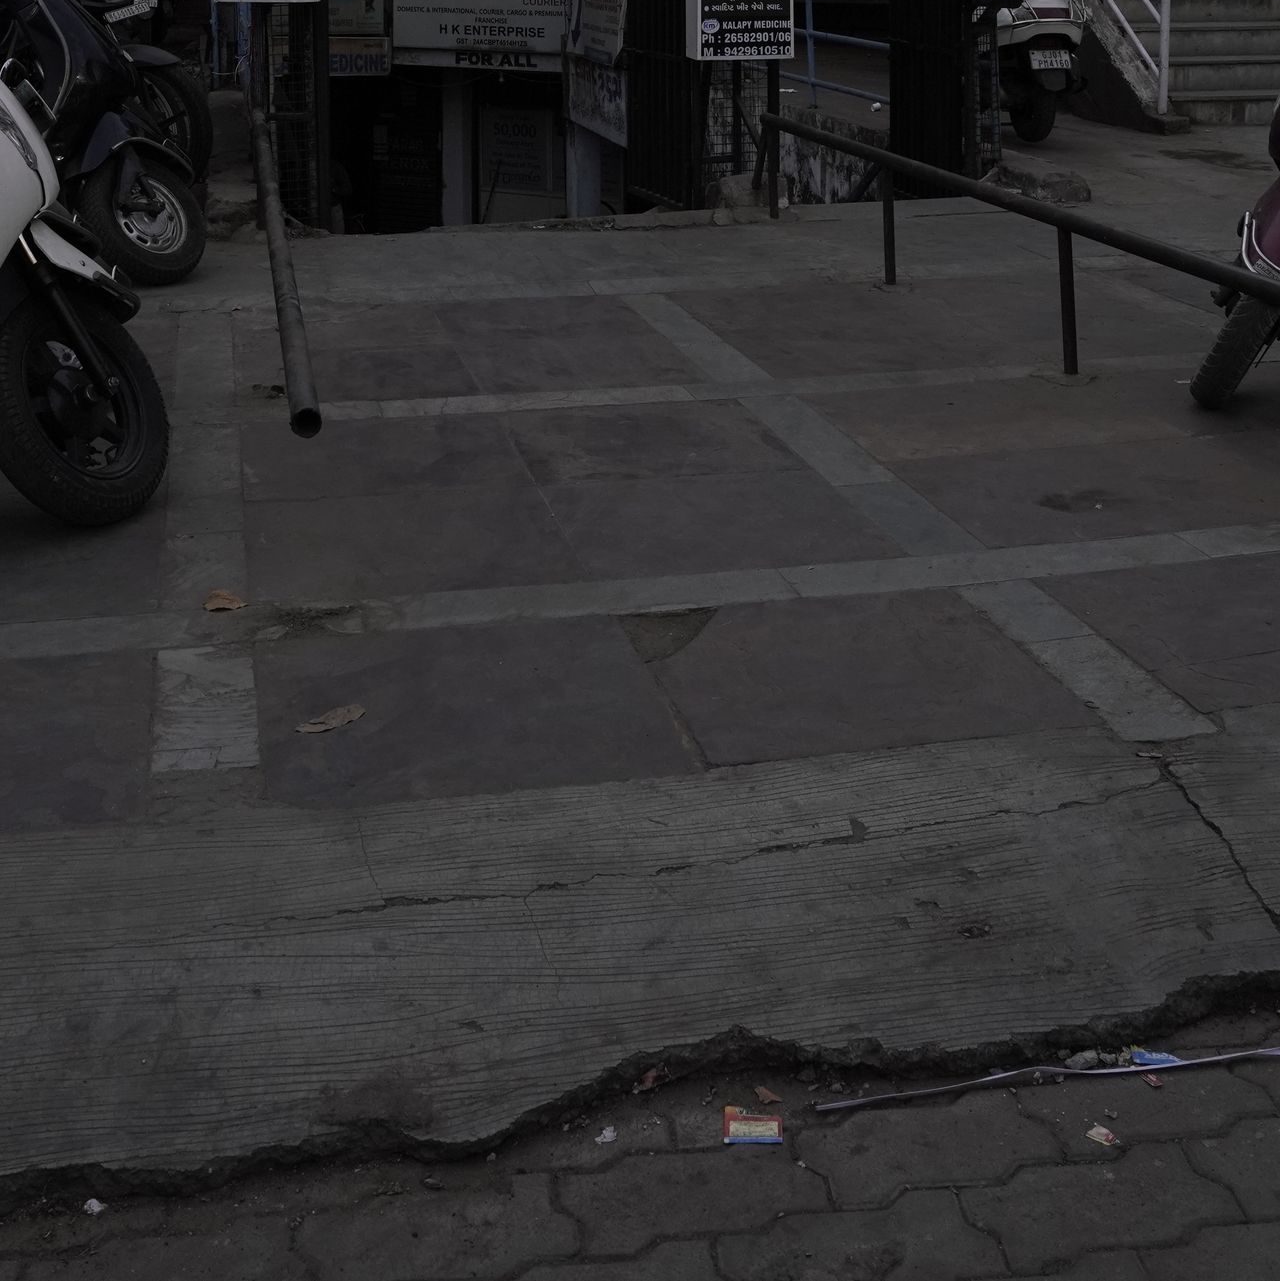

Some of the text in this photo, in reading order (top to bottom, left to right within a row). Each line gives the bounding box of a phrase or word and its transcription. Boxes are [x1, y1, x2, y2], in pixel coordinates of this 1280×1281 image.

[723, 20, 792, 29] KALAPY MEDICINE
[439, 24, 545, 38] H K ENTERPRISE
[702, 33, 791, 43] Ph 26582901/06
[704, 46, 791, 56] M 9429610510
[1042, 51, 1062, 59] GJ01
[455, 52, 537, 68] FOR ALL
[493, 122, 536, 138] 50,000
